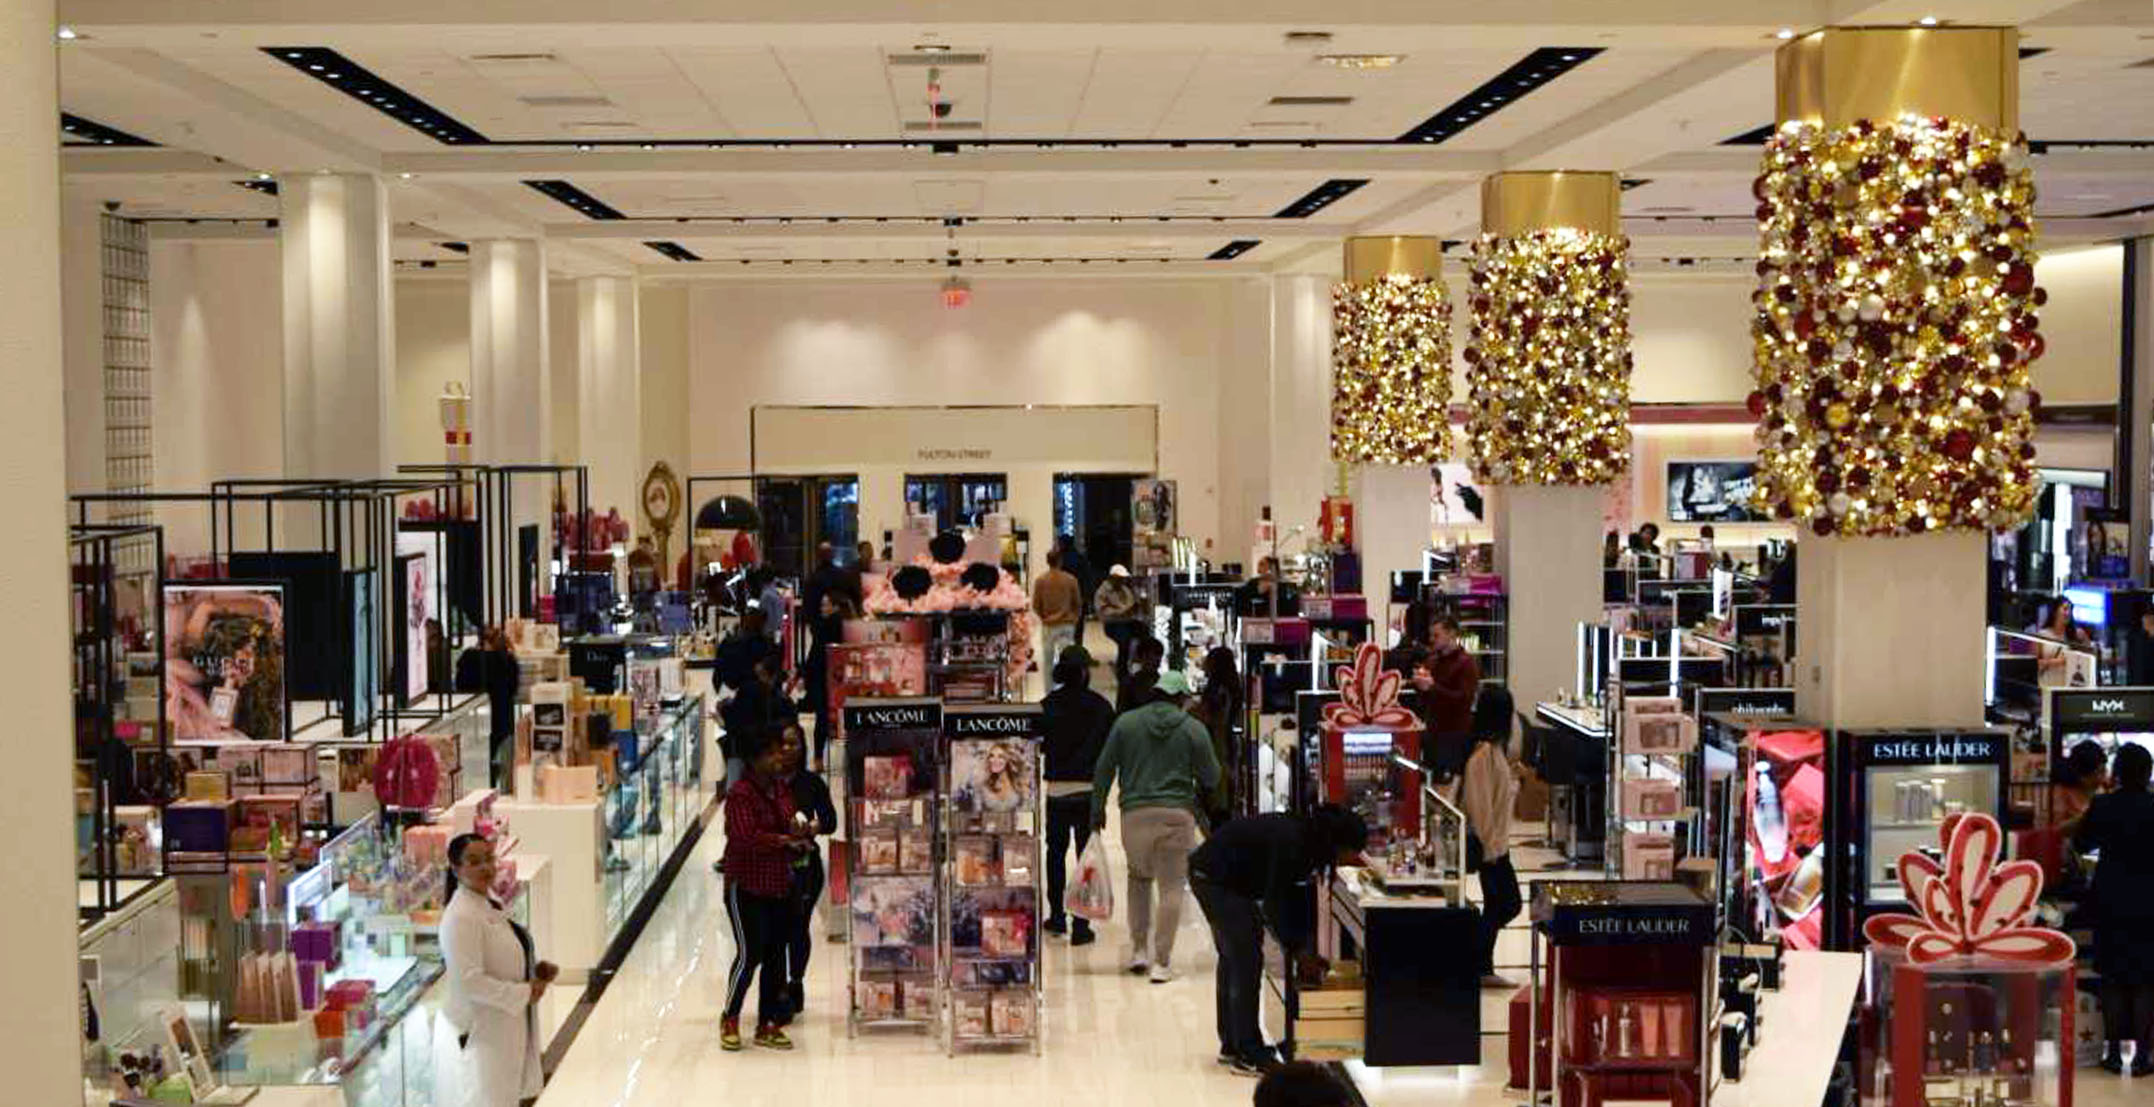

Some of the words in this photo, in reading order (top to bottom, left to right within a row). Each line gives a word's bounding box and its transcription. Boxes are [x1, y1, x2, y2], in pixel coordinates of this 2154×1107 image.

[959, 448, 992, 460] STREET
[2092, 700, 2124, 712] NYX
[856, 708, 929, 723] LANCÔME
[956, 716, 1034, 731] LANCÔME
[1874, 740, 1920, 757] ESTÉE
[1926, 743, 1990, 757] LAUDER
[1579, 917, 1619, 933] ESTÉE
[1626, 918, 1690, 933] LAUDER
